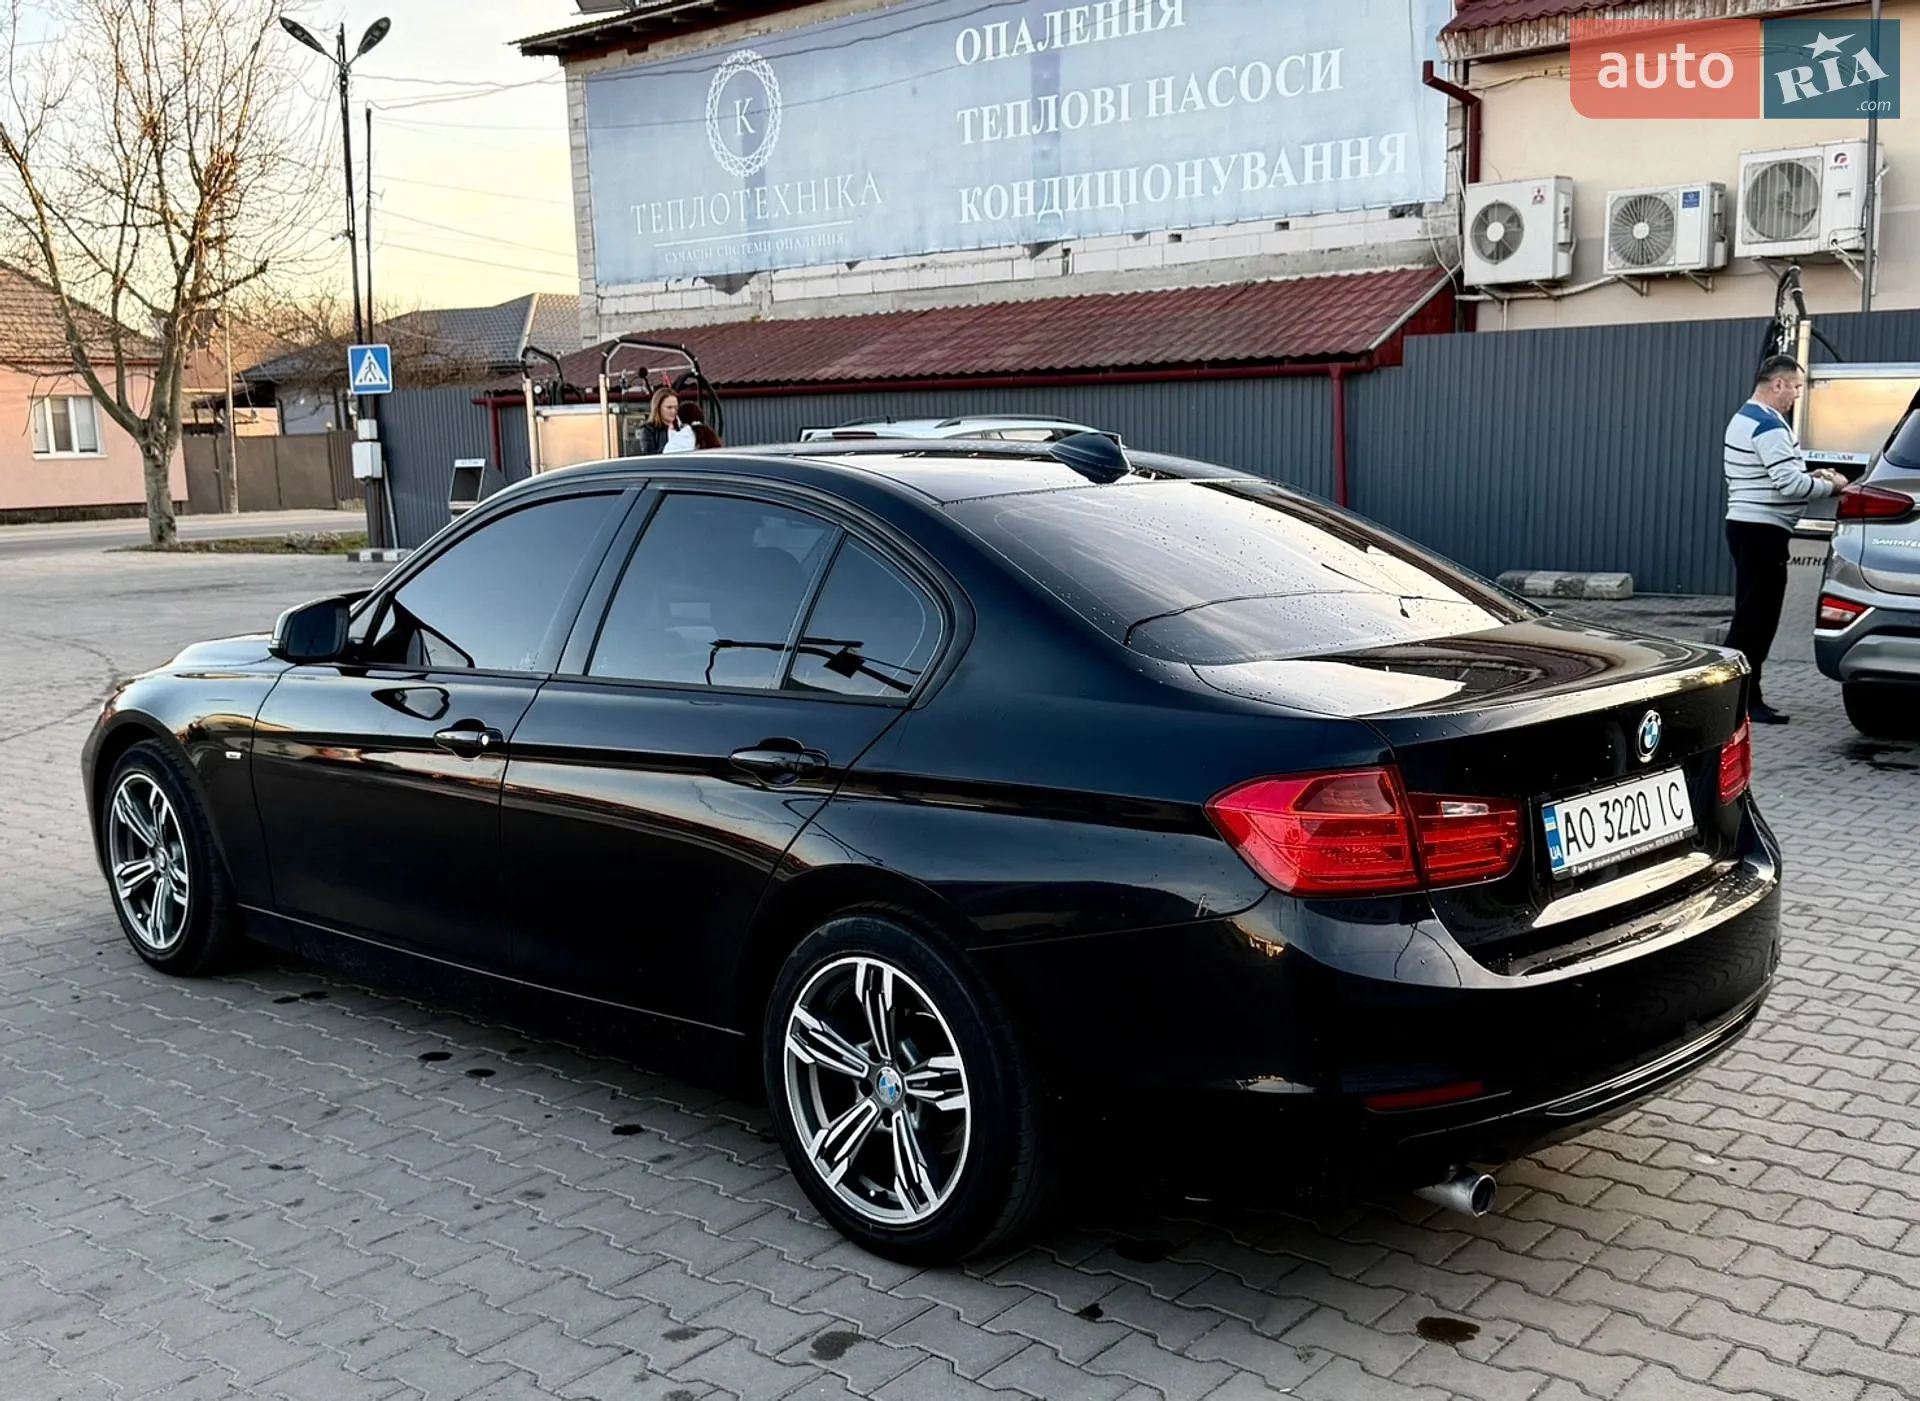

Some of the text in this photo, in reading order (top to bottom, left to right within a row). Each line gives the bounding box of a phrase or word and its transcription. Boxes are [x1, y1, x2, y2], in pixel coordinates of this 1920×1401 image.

[955, 0, 1185, 65] ОПАЛЕННЯ
[956, 47, 1345, 145] ТЕПЛОВІ НАСОСИ
[630, 170, 883, 235] ТЕПЛОТЕХНІКА
[958, 132, 1408, 225] КОНДИЦІОНУВАННЯ
[716, 240, 772, 257] СИСТЕМИ
[775, 232, 845, 252] ОПАЛЕННЯ
[1599, 791, 1651, 843] 3220
